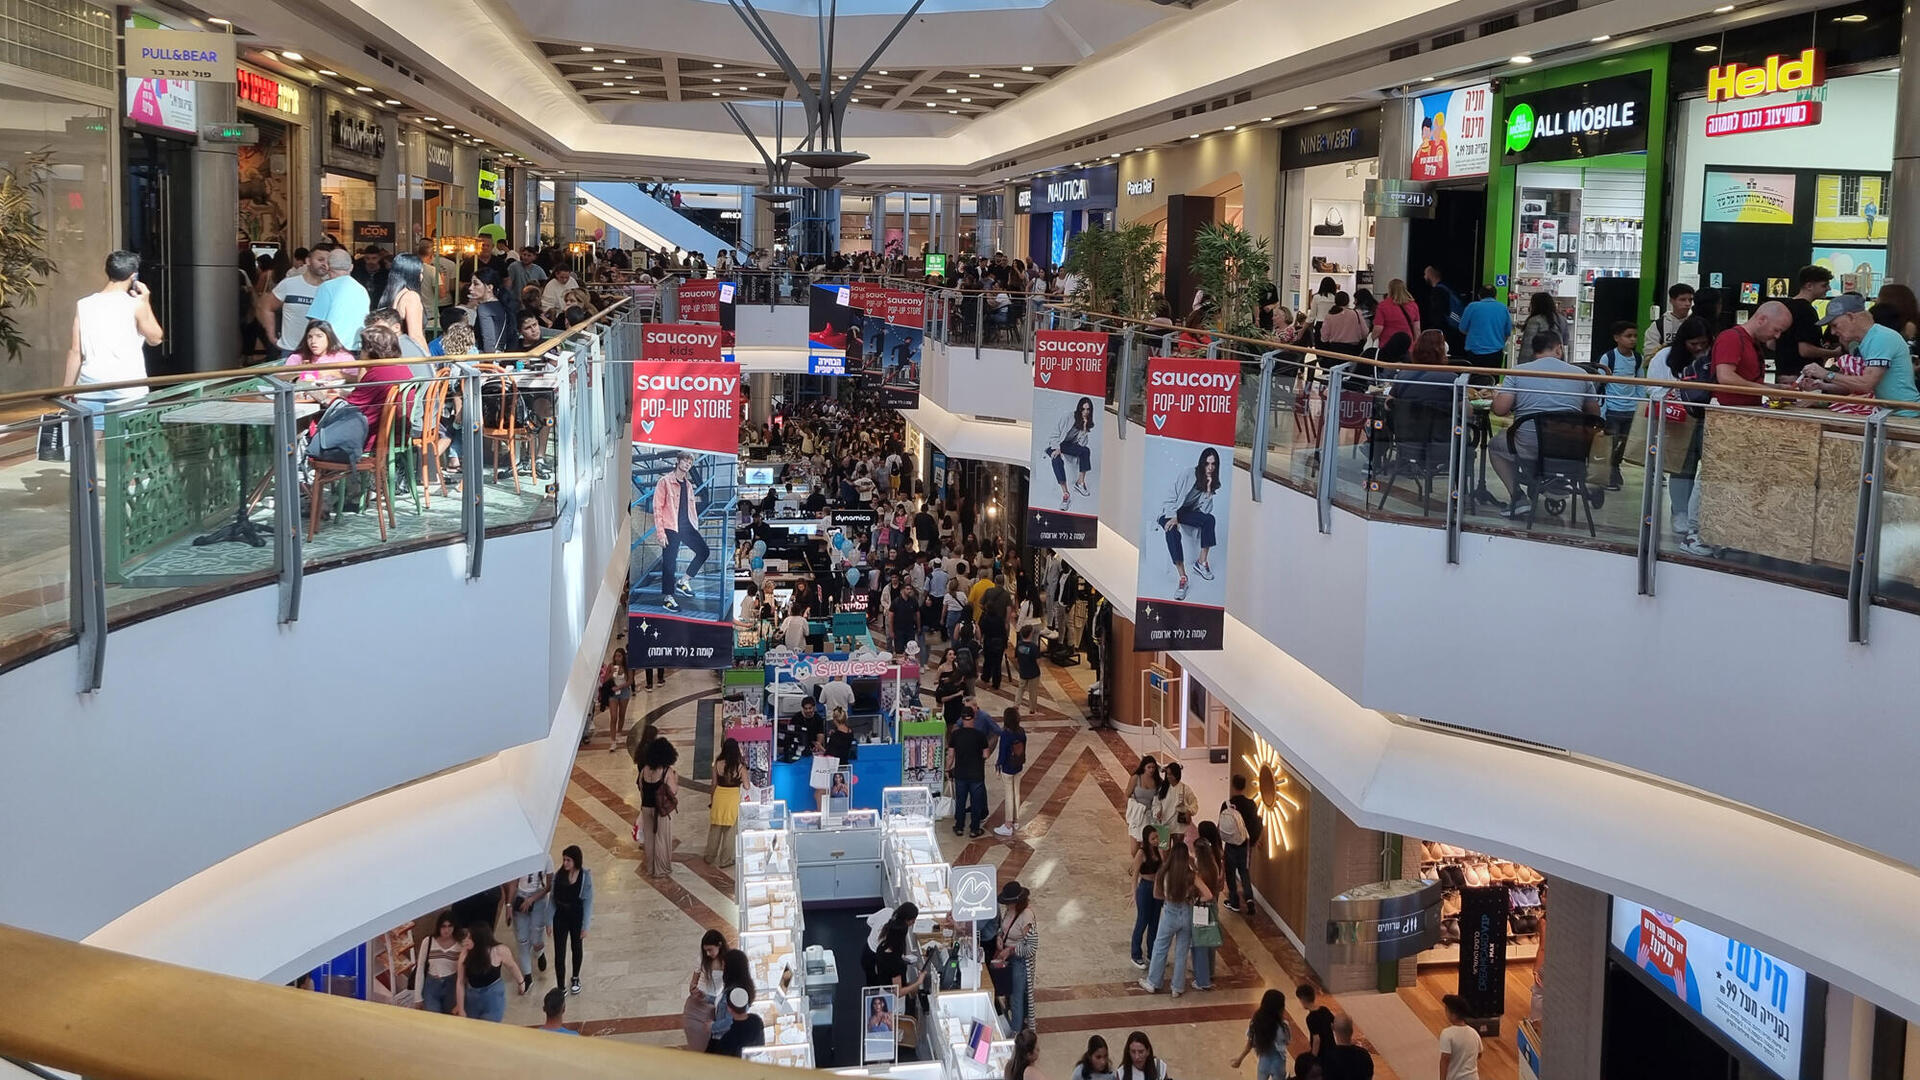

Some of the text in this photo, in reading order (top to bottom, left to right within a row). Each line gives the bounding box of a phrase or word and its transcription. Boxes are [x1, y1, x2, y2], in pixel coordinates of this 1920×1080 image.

[142, 47, 218, 63] PULL&BEAR
[168, 69, 189, 78] אנד
[192, 69, 212, 78] פול
[1707, 49, 1815, 103] Held
[1464, 89, 1485, 112] חניה
[1461, 115, 1485, 139] חינם!
[1534, 101, 1635, 138] ALL MOBILE
[1708, 114, 1740, 135] לתמונה
[1742, 110, 1763, 129] נכנס
[1300, 127, 1354, 154] NINE WEST
[1047, 179, 1086, 203] NAUTICA
[360, 227, 388, 236] ICON
[679, 290, 717, 299] saucony
[887, 297, 924, 307] saucony
[646, 331, 718, 348] saucony
[1038, 340, 1106, 356] saucony
[669, 345, 694, 356] kids
[1039, 356, 1102, 373] POP-UP STORE
[636, 374, 737, 396] saucony
[1151, 371, 1237, 392] saucony
[640, 398, 733, 419] POP-UP STORE
[1152, 393, 1232, 414] POP-UP STORE
[835, 514, 871, 523] dynamica
[1150, 628, 1207, 641] קומה 2 (ליד ארומה)
[647, 646, 714, 659] קומה 2 (ליד ארומה)
[1377, 921, 1401, 933] שרותים
[1725, 938, 1789, 1014] חינם!
[1739, 988, 1758, 1019] מעל
[1759, 1005, 1790, 1043] בקנייה
